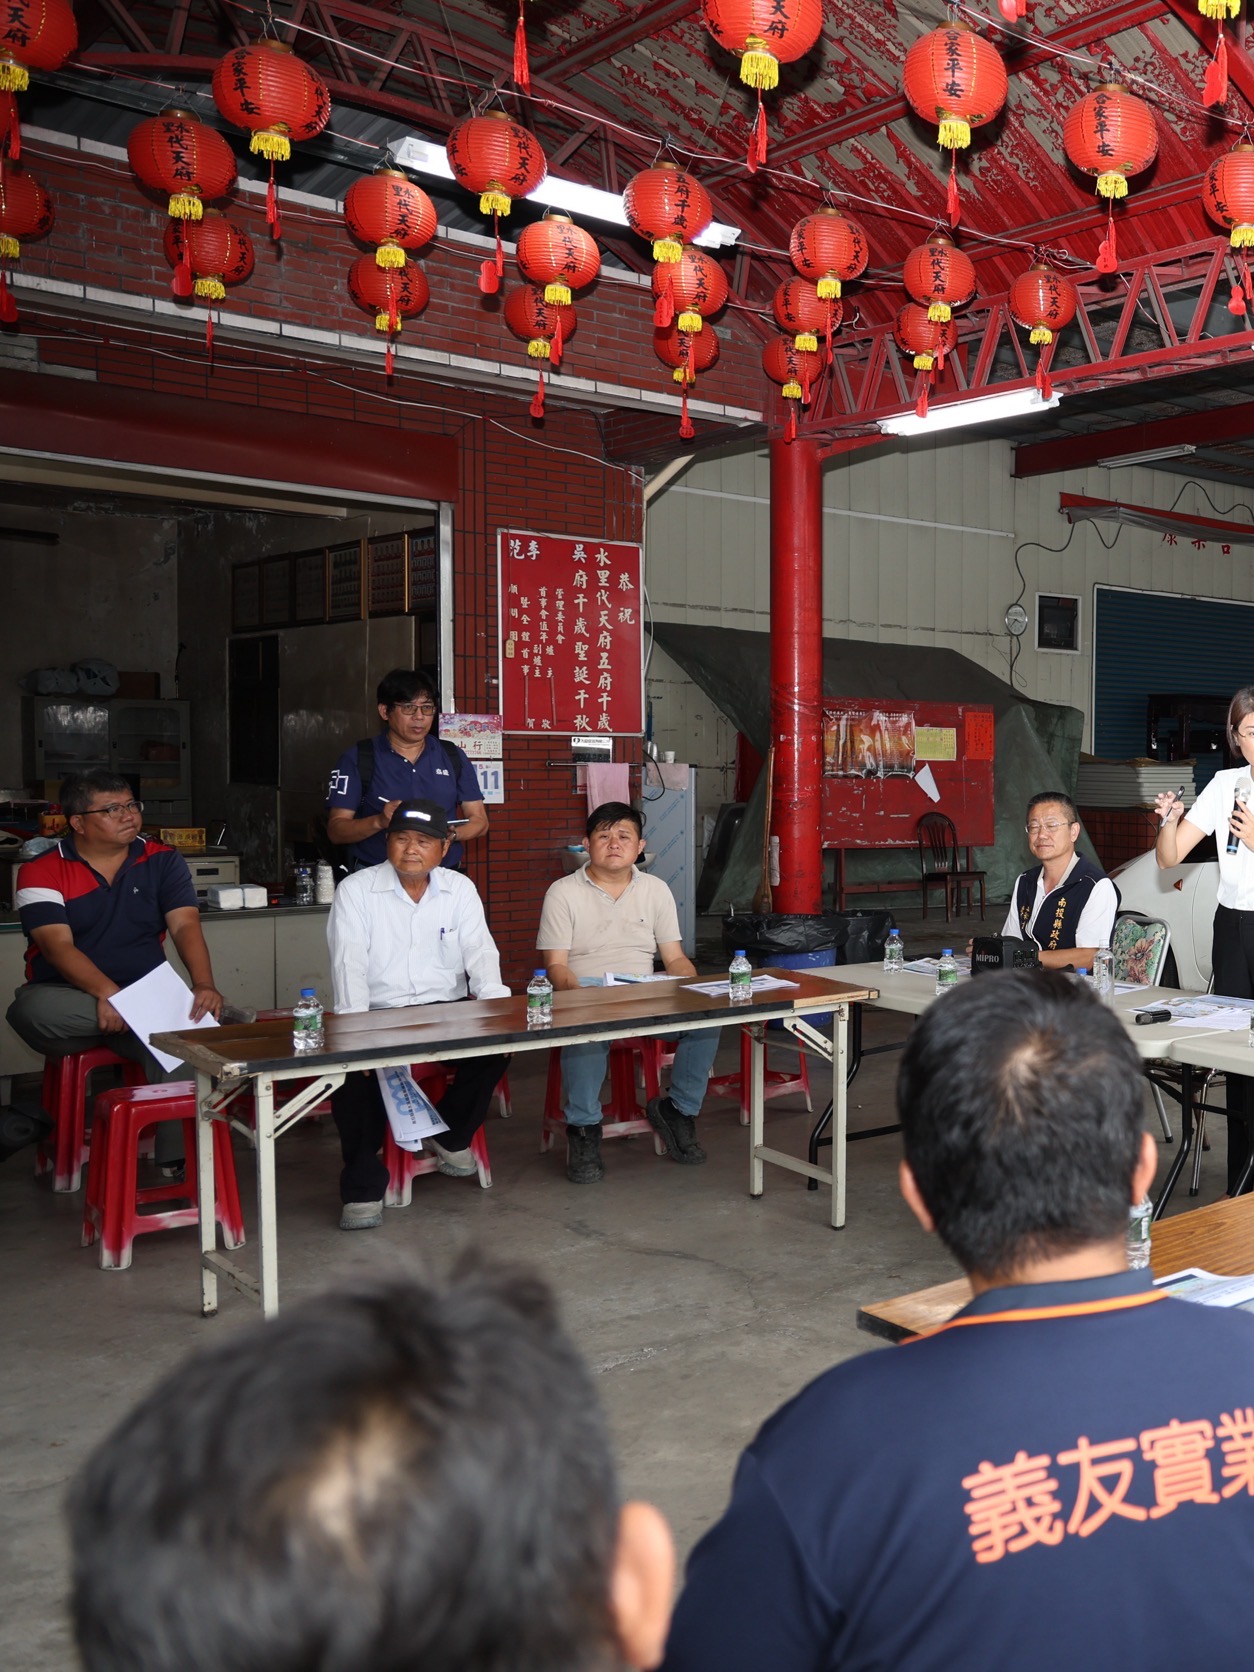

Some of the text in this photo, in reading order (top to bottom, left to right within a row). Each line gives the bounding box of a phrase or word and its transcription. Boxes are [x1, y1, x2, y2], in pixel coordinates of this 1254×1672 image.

[944, 28, 965, 99] 合家平安
[1093, 93, 1115, 157] 合家平安
[617, 572, 637, 626] 恭祝
[480, 770, 500, 790] 11
[1047, 896, 1067, 951] 南投縣政府
